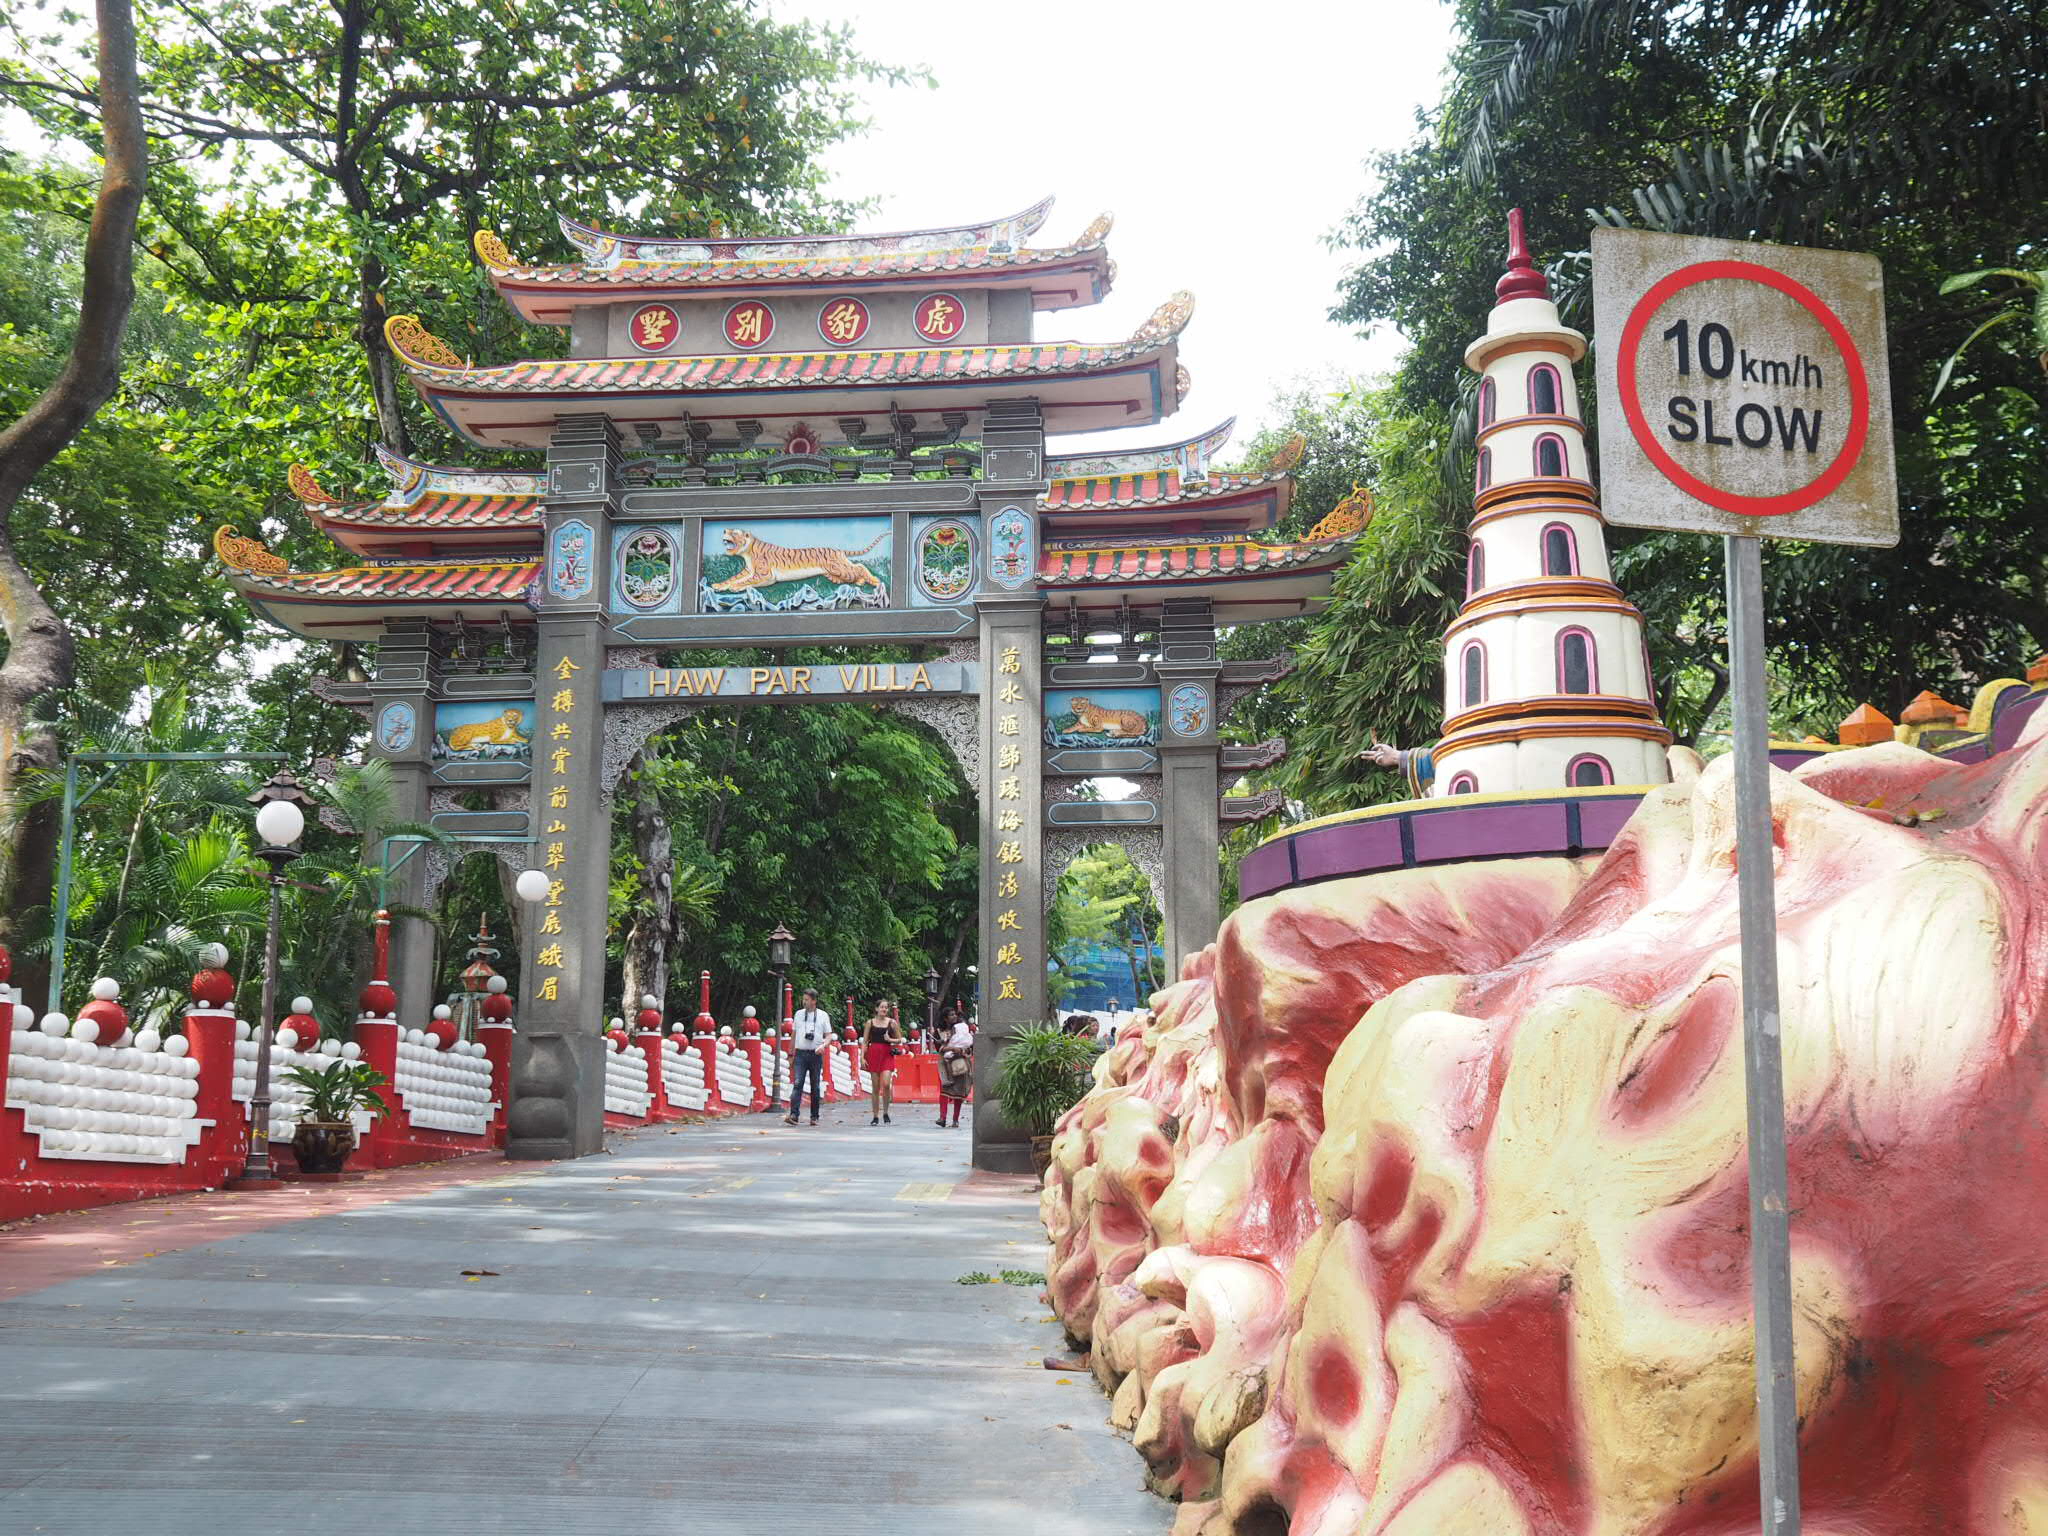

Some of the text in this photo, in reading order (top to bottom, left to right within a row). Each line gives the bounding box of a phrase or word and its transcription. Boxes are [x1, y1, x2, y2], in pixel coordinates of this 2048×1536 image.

[1663, 319, 1823, 389] 10 km/h
[1667, 396, 1823, 453] SLOW
[649, 663, 934, 697] HAW PAR VILLA
